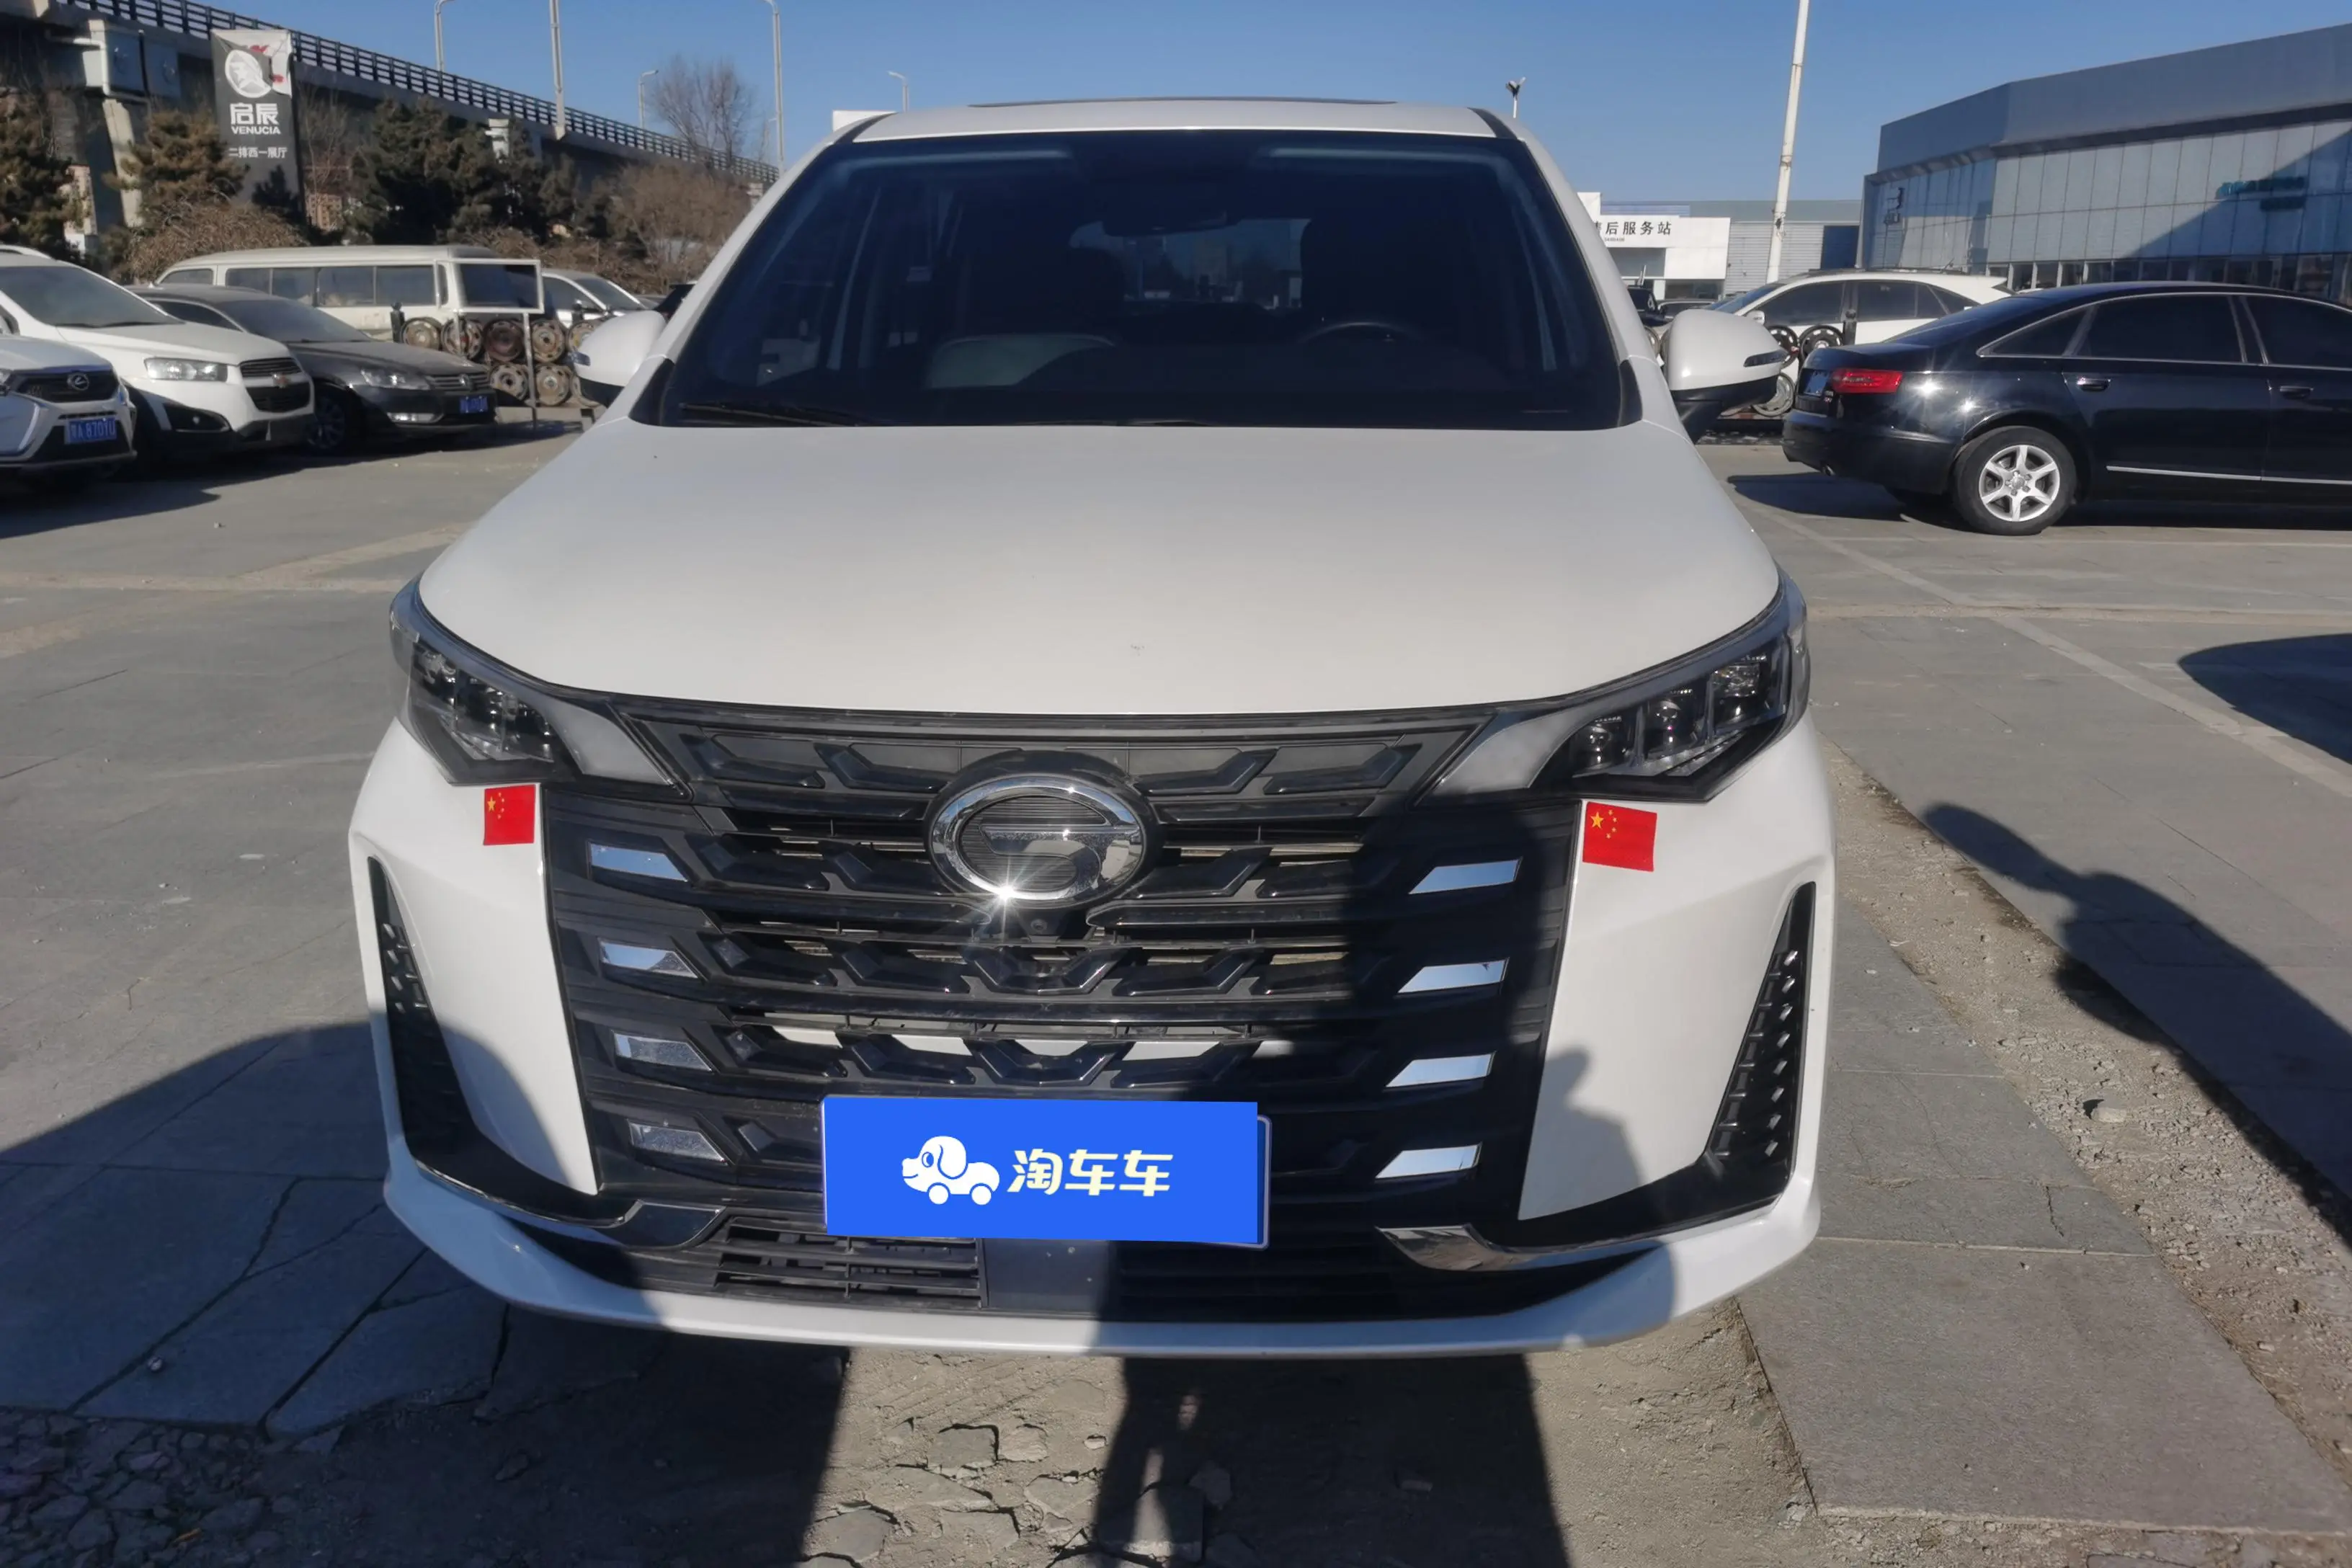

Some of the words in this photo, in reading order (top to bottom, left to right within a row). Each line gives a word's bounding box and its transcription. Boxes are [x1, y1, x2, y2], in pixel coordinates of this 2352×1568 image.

[230, 102, 279, 125] 启辰
[231, 126, 281, 135] VENUCIA
[228, 146, 288, 159] 二排西一展厅
